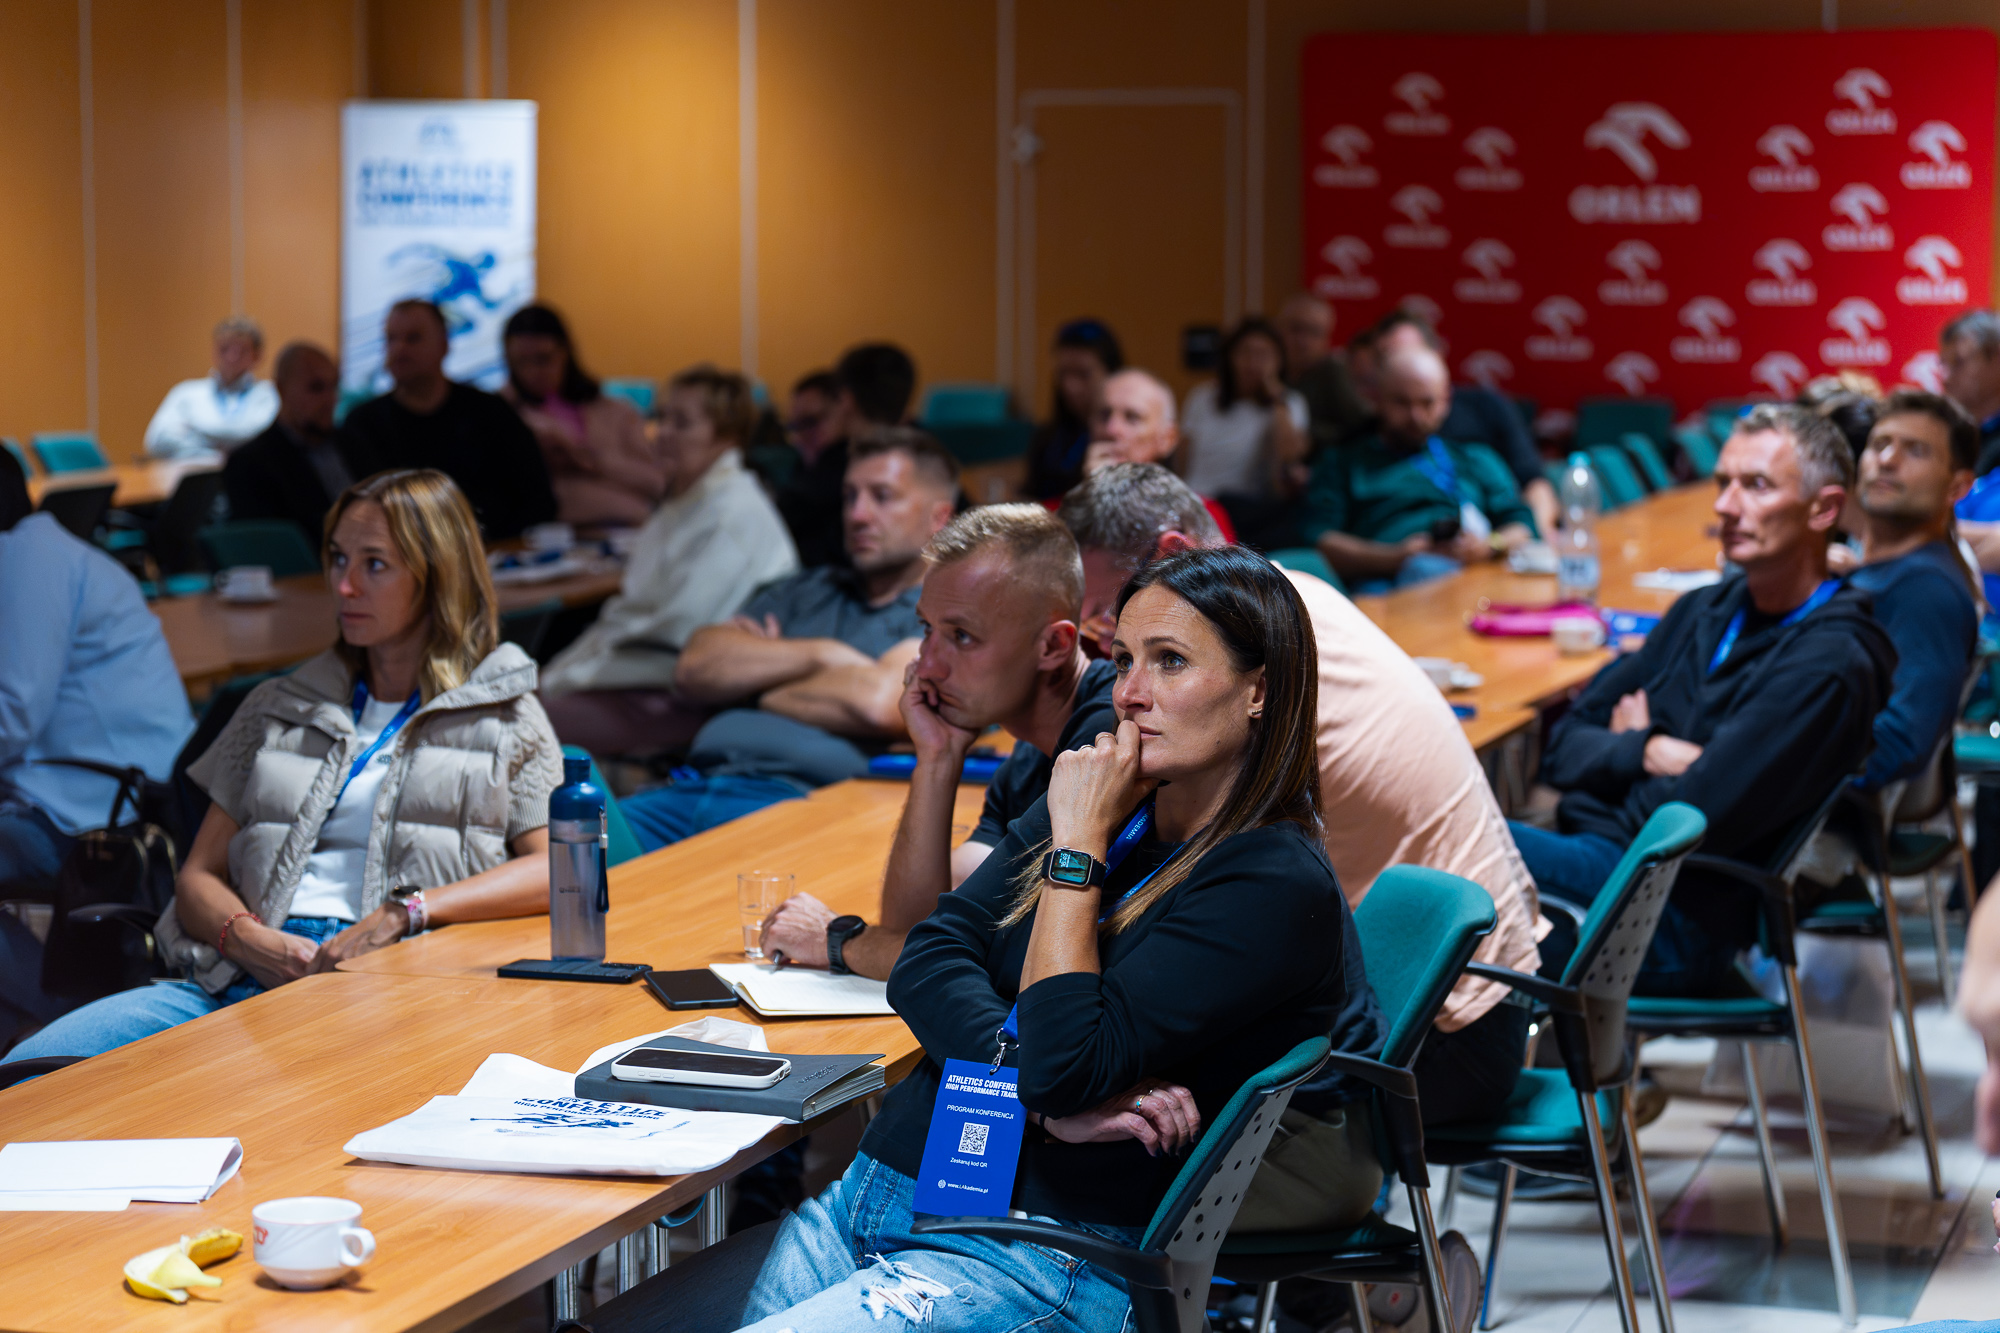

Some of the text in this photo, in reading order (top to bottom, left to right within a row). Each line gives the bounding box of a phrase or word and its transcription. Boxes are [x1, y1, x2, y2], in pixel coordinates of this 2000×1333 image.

[1569, 187, 1700, 223] ORLEN
[947, 1074, 984, 1087] ATHLETICS
[945, 1083, 1019, 1100] HIGH PERFORMANCE TRAIN
[946, 1104, 1015, 1120] PROGRAM KONFERENCJI
[950, 1156, 970, 1167] Zeskanuj
